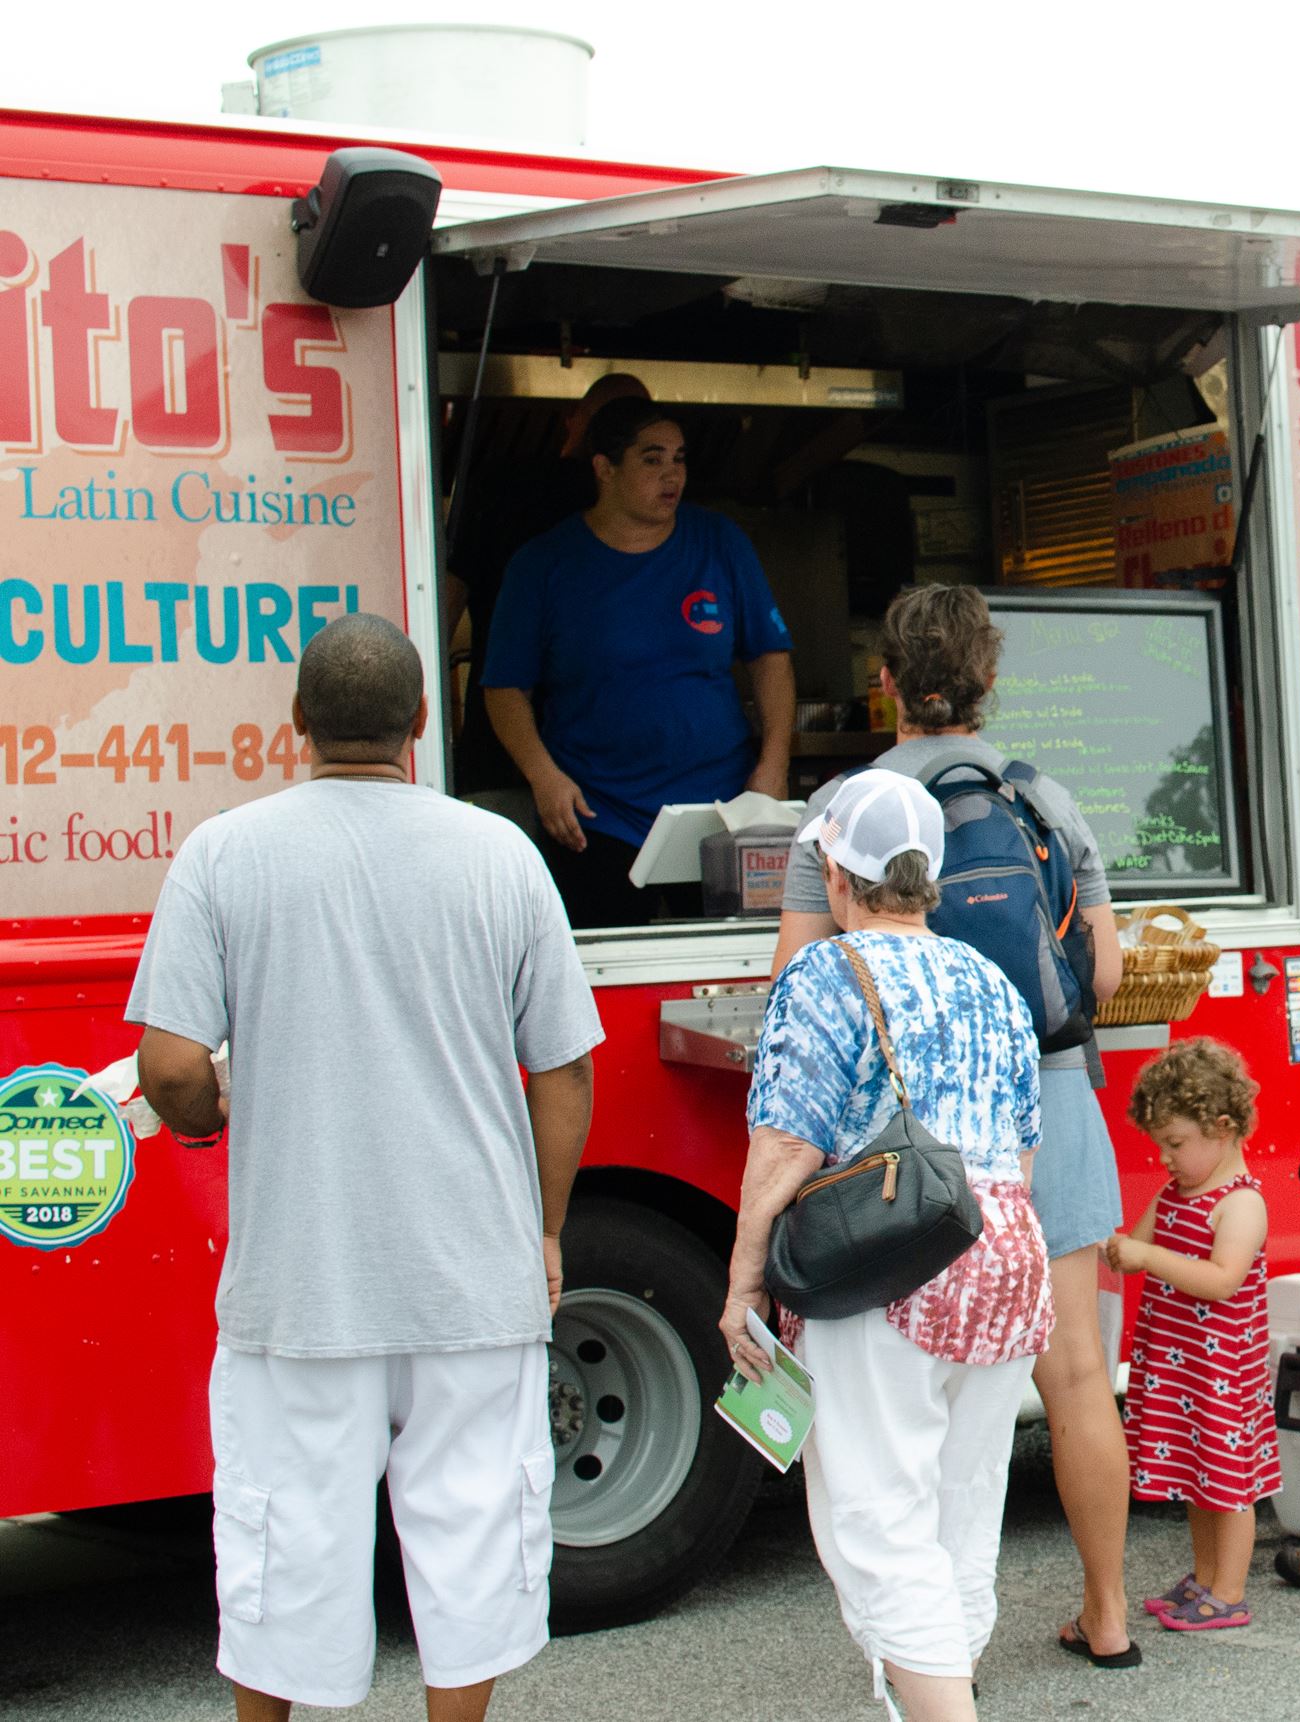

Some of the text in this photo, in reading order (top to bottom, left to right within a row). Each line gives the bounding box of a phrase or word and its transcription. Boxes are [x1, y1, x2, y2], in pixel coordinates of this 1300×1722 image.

[19, 465, 356, 528] Latin Cuisine
[0, 722, 312, 785] 12-441-84
[62, 810, 174, 861] food!
[0, 1112, 107, 1134] Connect
[0, 1139, 116, 1181] BEST
[0, 1186, 108, 1198] F SAVANNAH
[26, 1206, 73, 1223] 2018
